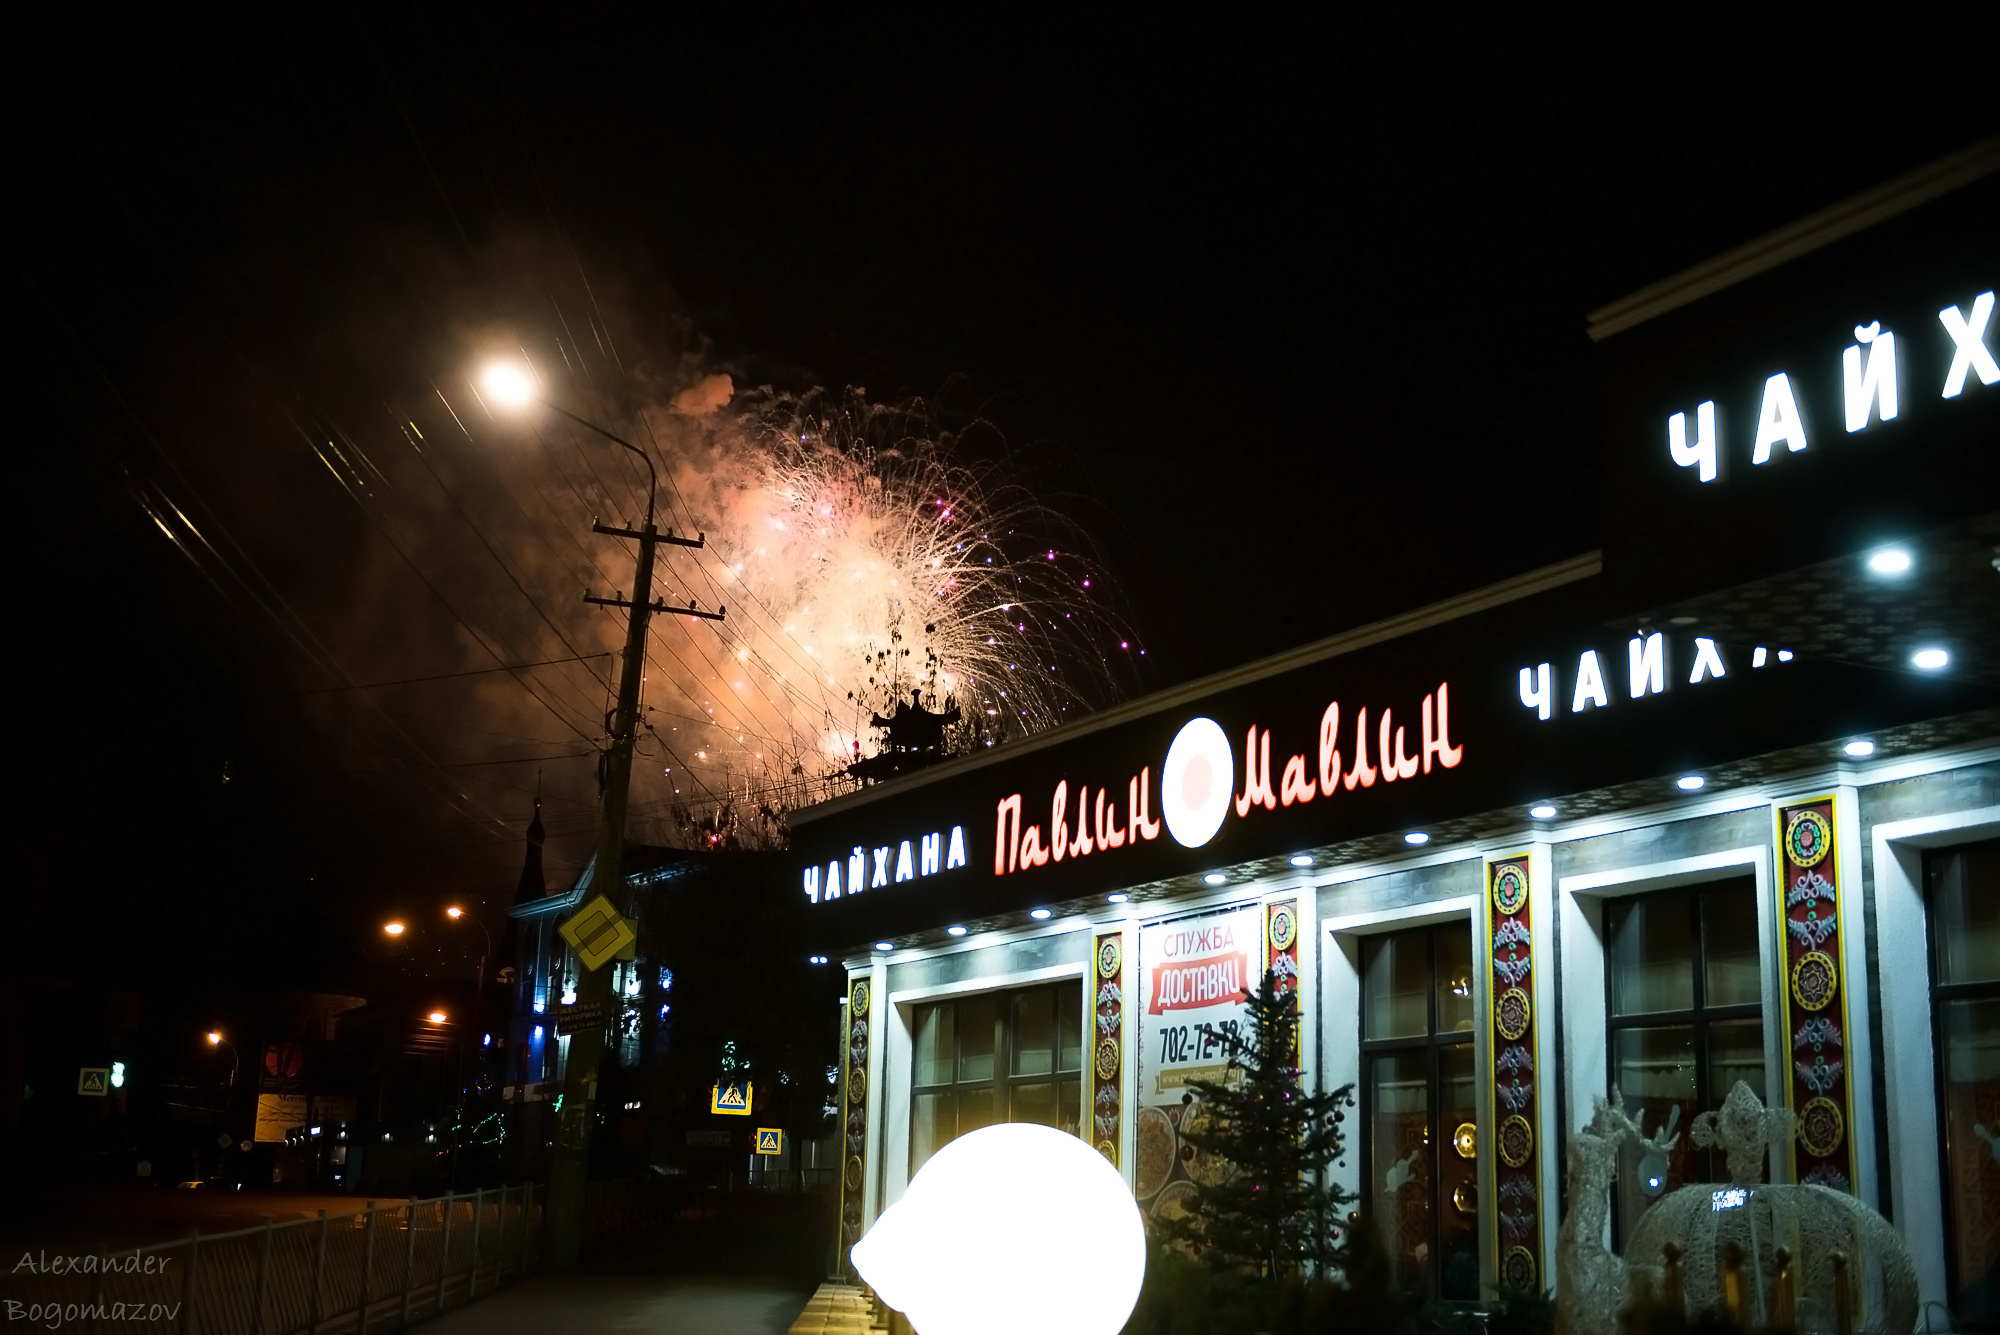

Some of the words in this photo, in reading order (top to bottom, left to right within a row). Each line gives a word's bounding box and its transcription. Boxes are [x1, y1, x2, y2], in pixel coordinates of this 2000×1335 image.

[993, 765, 1161, 876] Павлин
[1235, 681, 1463, 818] Мавлин
[803, 825, 966, 904] ЧАЙХАНА
[1164, 925, 1235, 957] СЛУЖБА
[1157, 956, 1241, 1008] ДОСТАВКИ
